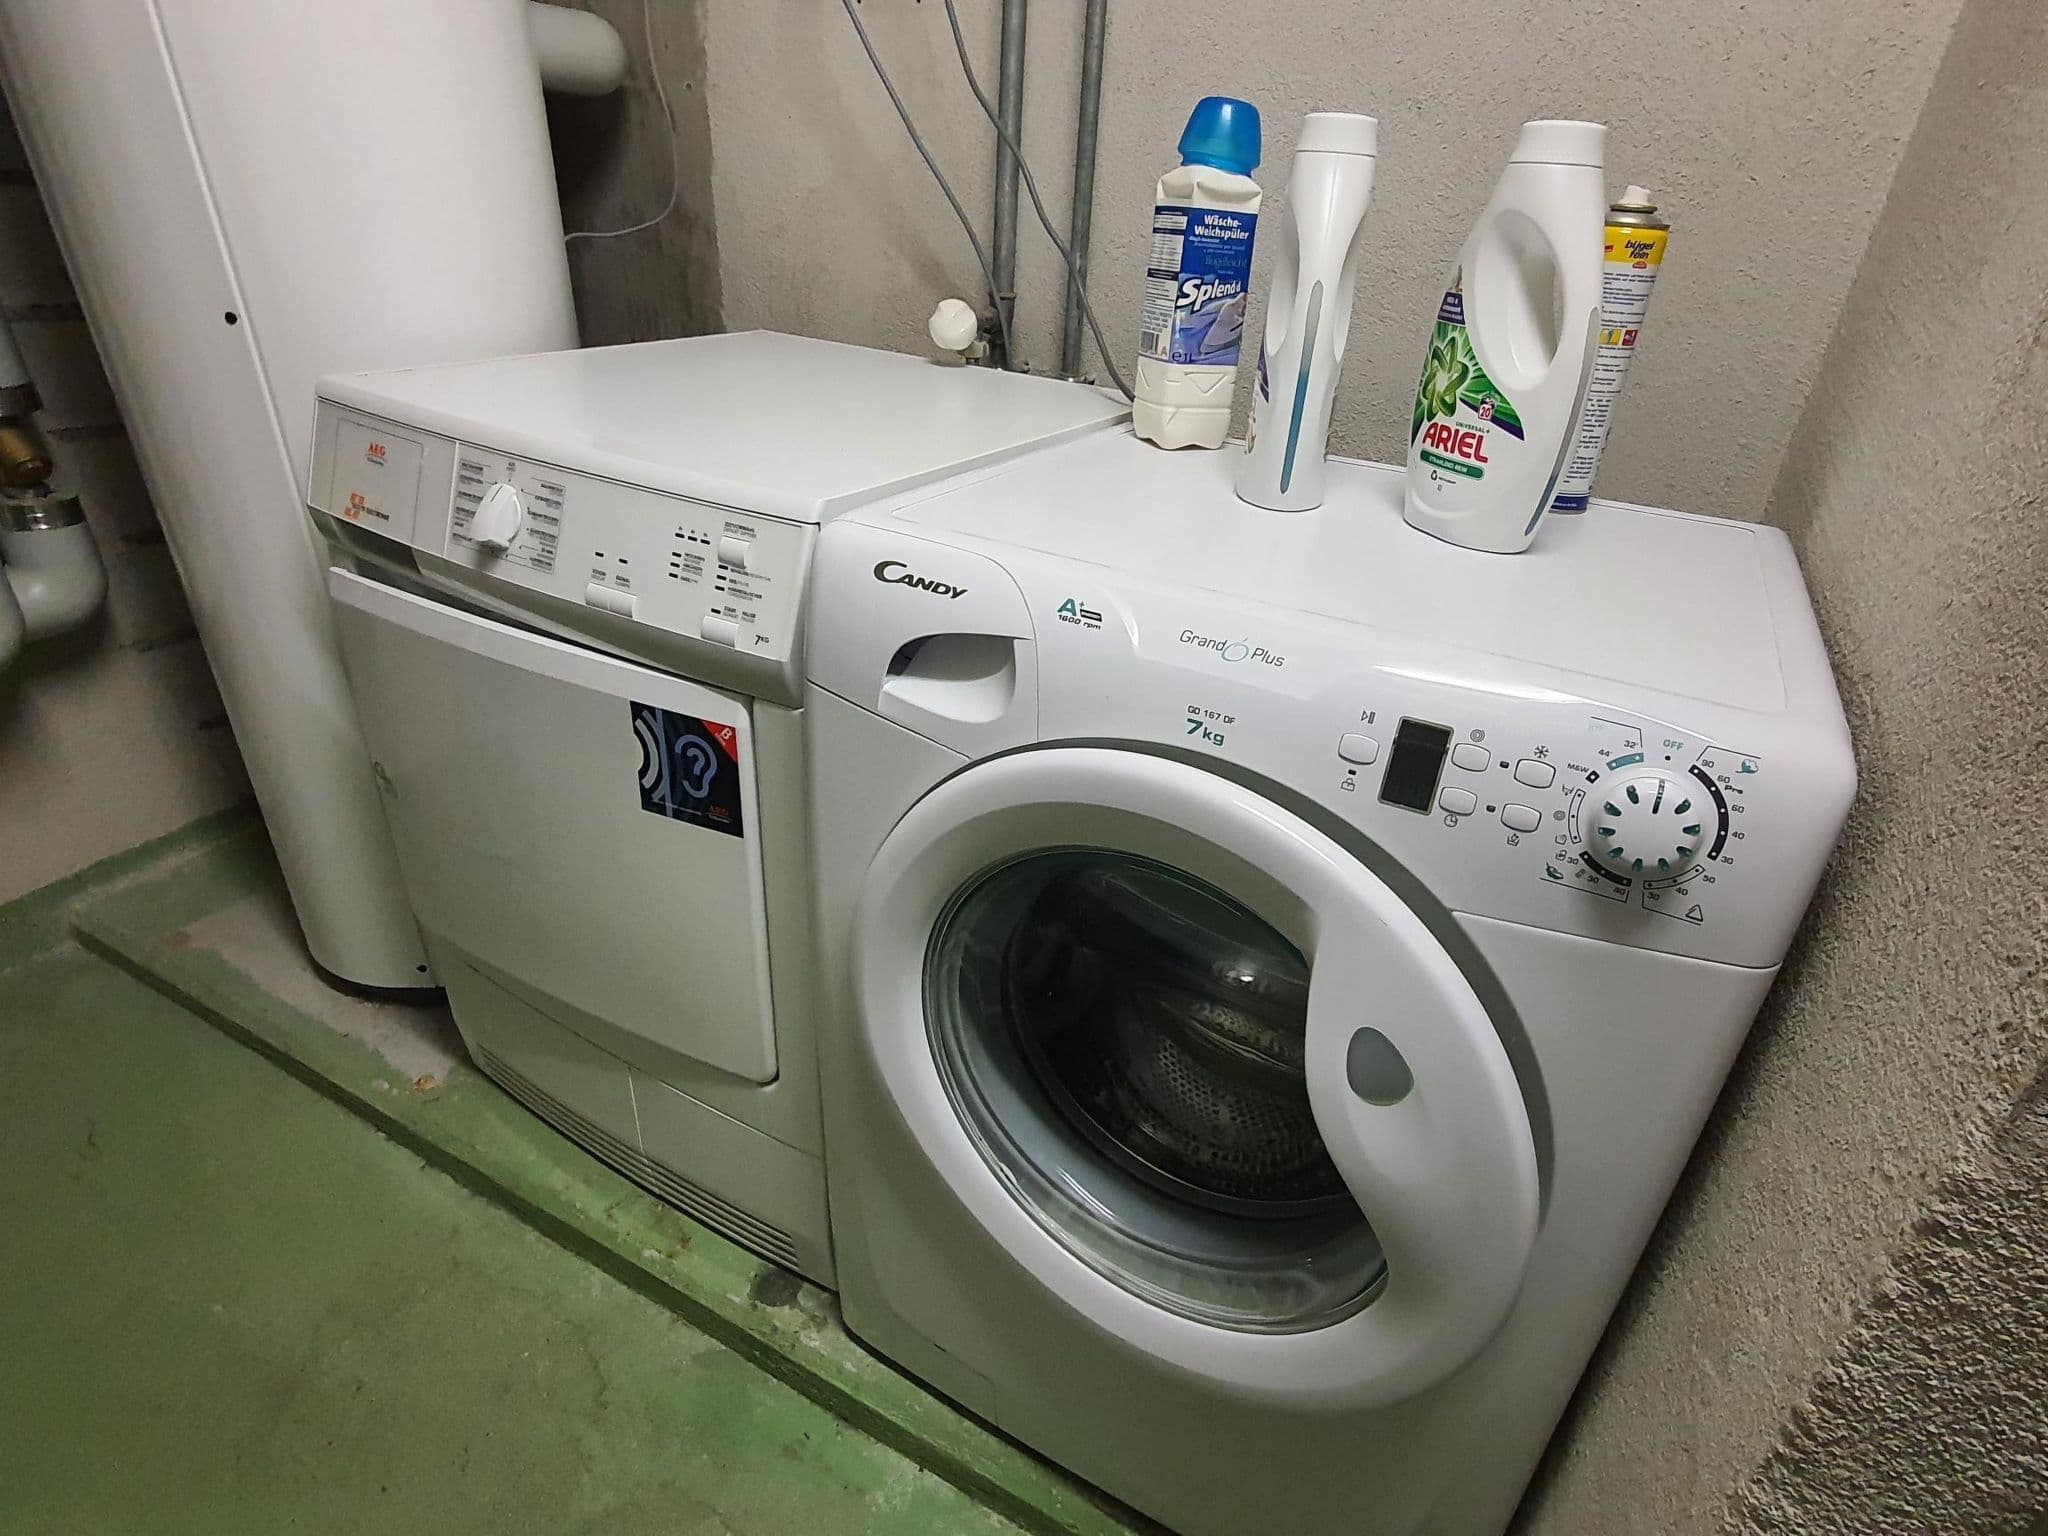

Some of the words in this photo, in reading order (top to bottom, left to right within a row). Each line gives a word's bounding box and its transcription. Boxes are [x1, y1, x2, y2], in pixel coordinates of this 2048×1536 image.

[1204, 214, 1242, 227] Wäsche-
[1194, 225, 1249, 240] Weichspüler
[1176, 279, 1241, 311] Splendd
[1480, 406, 1491, 418] 20
[1422, 422, 1489, 464] ARIEL
[1058, 614, 1082, 625] 1600
[1083, 622, 1101, 631] rpm
[1250, 647, 1285, 667] Plus
[1203, 710, 1222, 721] 167
[1223, 715, 1237, 725] DF
[720, 728, 732, 740] B
[1663, 739, 1684, 750] OFF
[1701, 759, 1715, 769] 90
[1717, 774, 1731, 784] 60
[1731, 804, 1745, 814] 60
[1731, 831, 1745, 841] 40
[1566, 857, 1579, 866] 30
[1720, 855, 1734, 865] 30
[1703, 874, 1716, 884] 50
[1646, 891, 1660, 901] 30
[1675, 886, 1689, 896] 40
